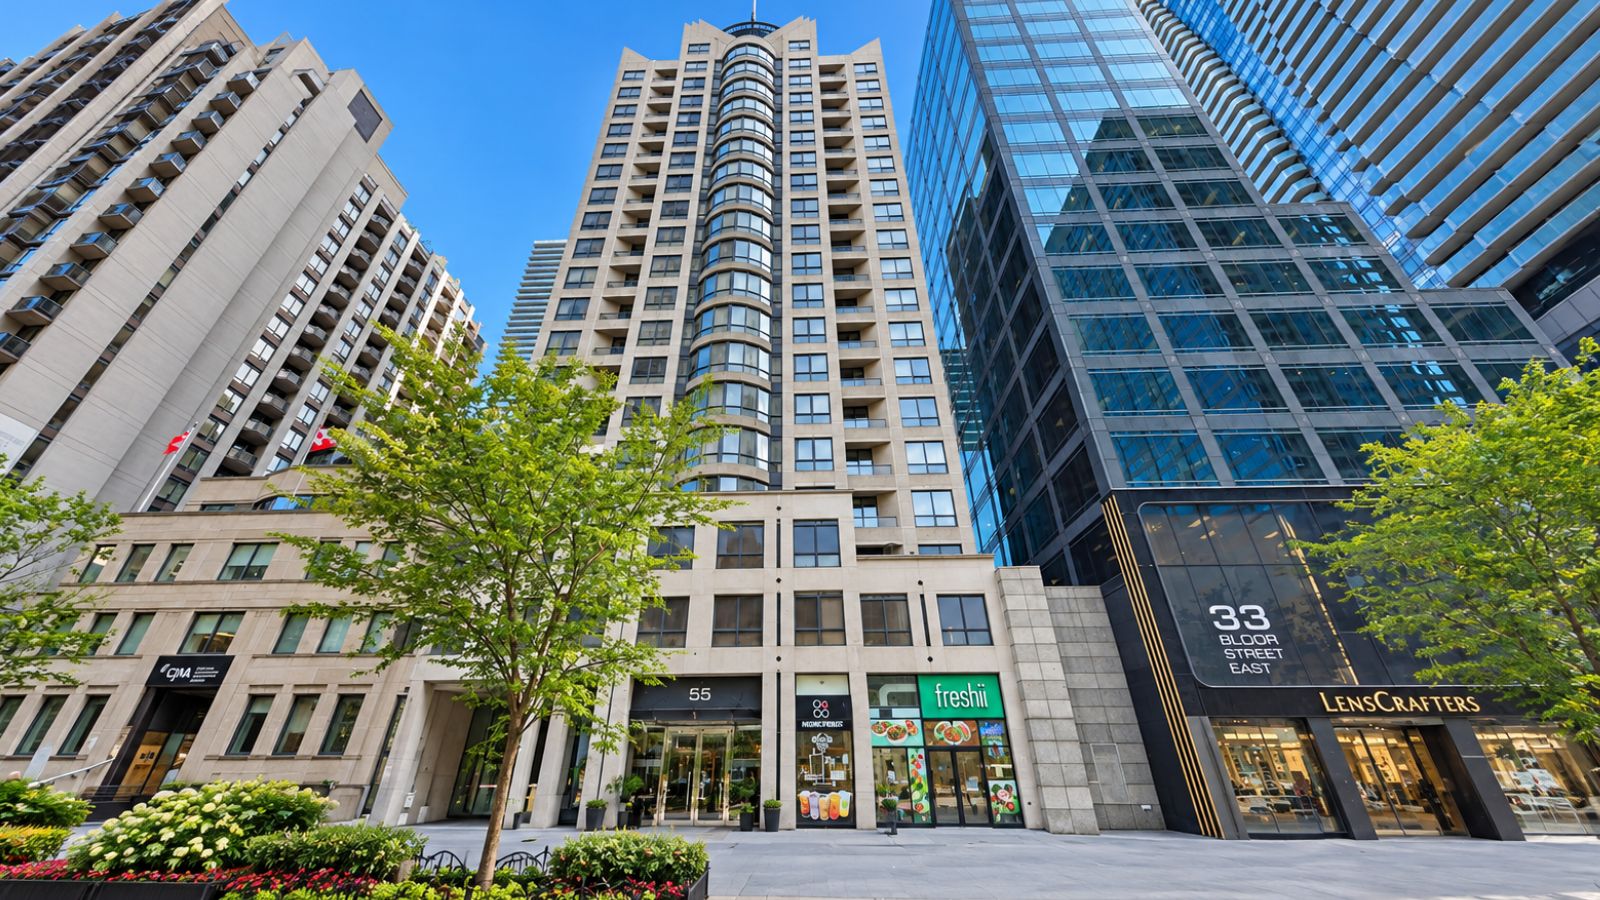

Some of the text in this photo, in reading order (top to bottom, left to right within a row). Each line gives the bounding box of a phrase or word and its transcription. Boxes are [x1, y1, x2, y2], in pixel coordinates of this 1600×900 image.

[1209, 604, 1271, 631] 33
[1219, 634, 1280, 646] BLOOR
[1223, 648, 1283, 660] STREET
[1229, 662, 1271, 675] EAST
[689, 687, 711, 701] 55
[934, 682, 989, 708] freshii
[1318, 690, 1481, 713] LENSCRAFTERS
